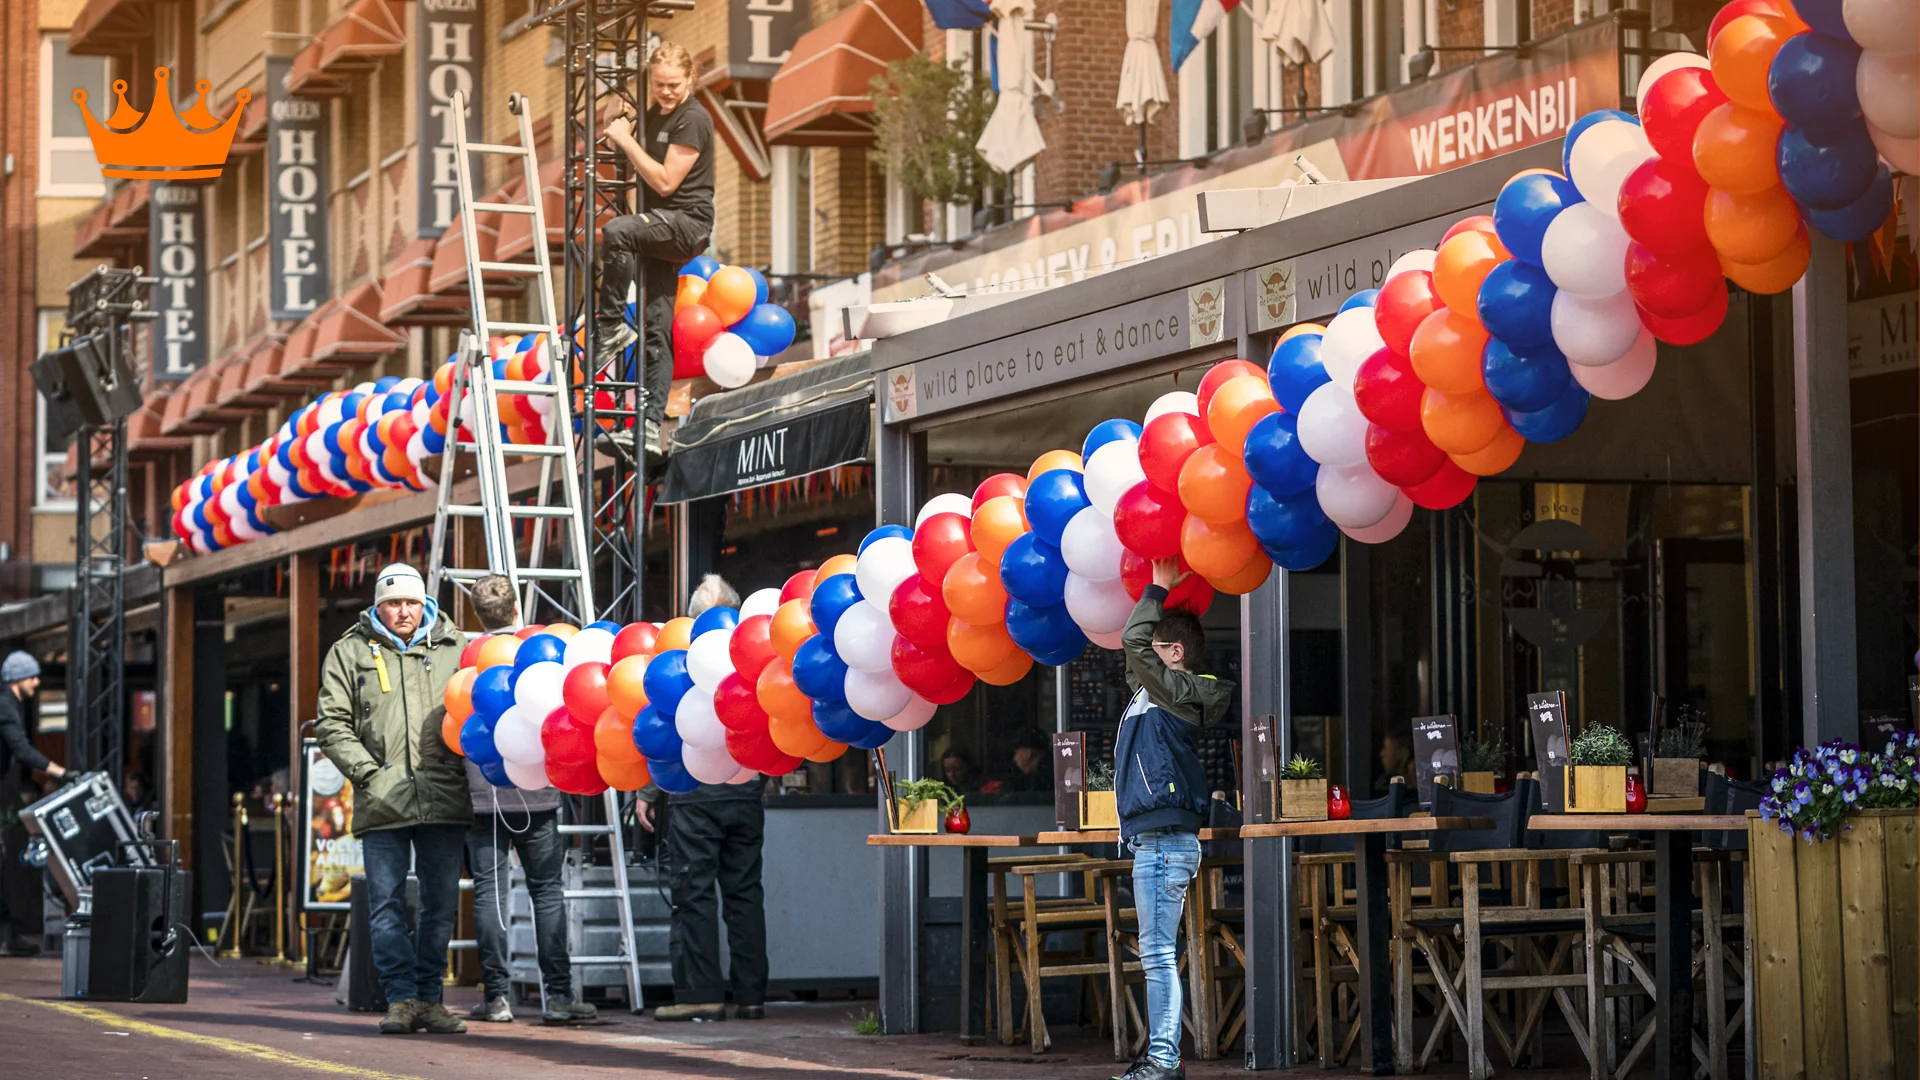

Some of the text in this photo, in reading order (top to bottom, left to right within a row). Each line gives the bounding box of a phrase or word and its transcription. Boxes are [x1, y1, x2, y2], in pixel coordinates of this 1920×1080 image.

[428, 21, 473, 228] HOTEL
[1410, 76, 1576, 172] WERKENBIJ
[277, 129, 317, 311] HOTEL
[160, 211, 196, 374] HOTEL
[1307, 258, 1356, 300] wild
[924, 371, 957, 400] wild
[966, 357, 1016, 395] place
[1026, 347, 1044, 374] to
[1054, 333, 1085, 366] eat
[1096, 327, 1108, 356] &
[1114, 314, 1179, 351] dance
[737, 427, 788, 474] MINT
